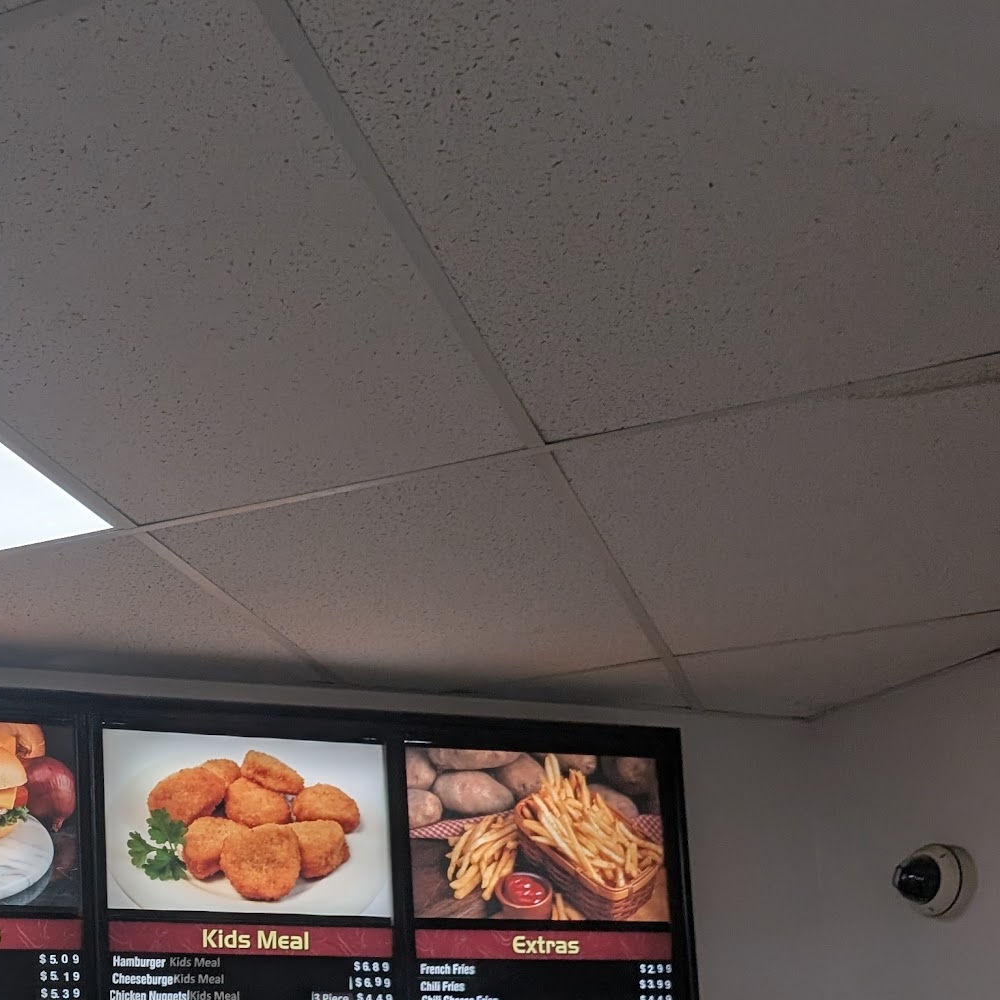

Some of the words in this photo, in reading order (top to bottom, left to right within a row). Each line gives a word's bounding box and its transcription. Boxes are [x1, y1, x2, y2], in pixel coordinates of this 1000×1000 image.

[202, 929, 251, 949] Kids
[257, 930, 310, 951] Meal
[512, 936, 580, 954] Extras
[112, 955, 166, 969] Hamburger
[169, 957, 191, 968] Kids
[193, 957, 221, 968] Meal
[420, 963, 451, 975] French
[452, 963, 476, 975] Fries
[173, 974, 195, 984] Kids
[197, 973, 225, 984] Meal
[420, 981, 441, 992] Chili
[442, 981, 466, 992] Fries
[109, 989, 147, 1000] Chicken
[190, 991, 212, 1000] Kids
[213, 990, 241, 1000] Meal
